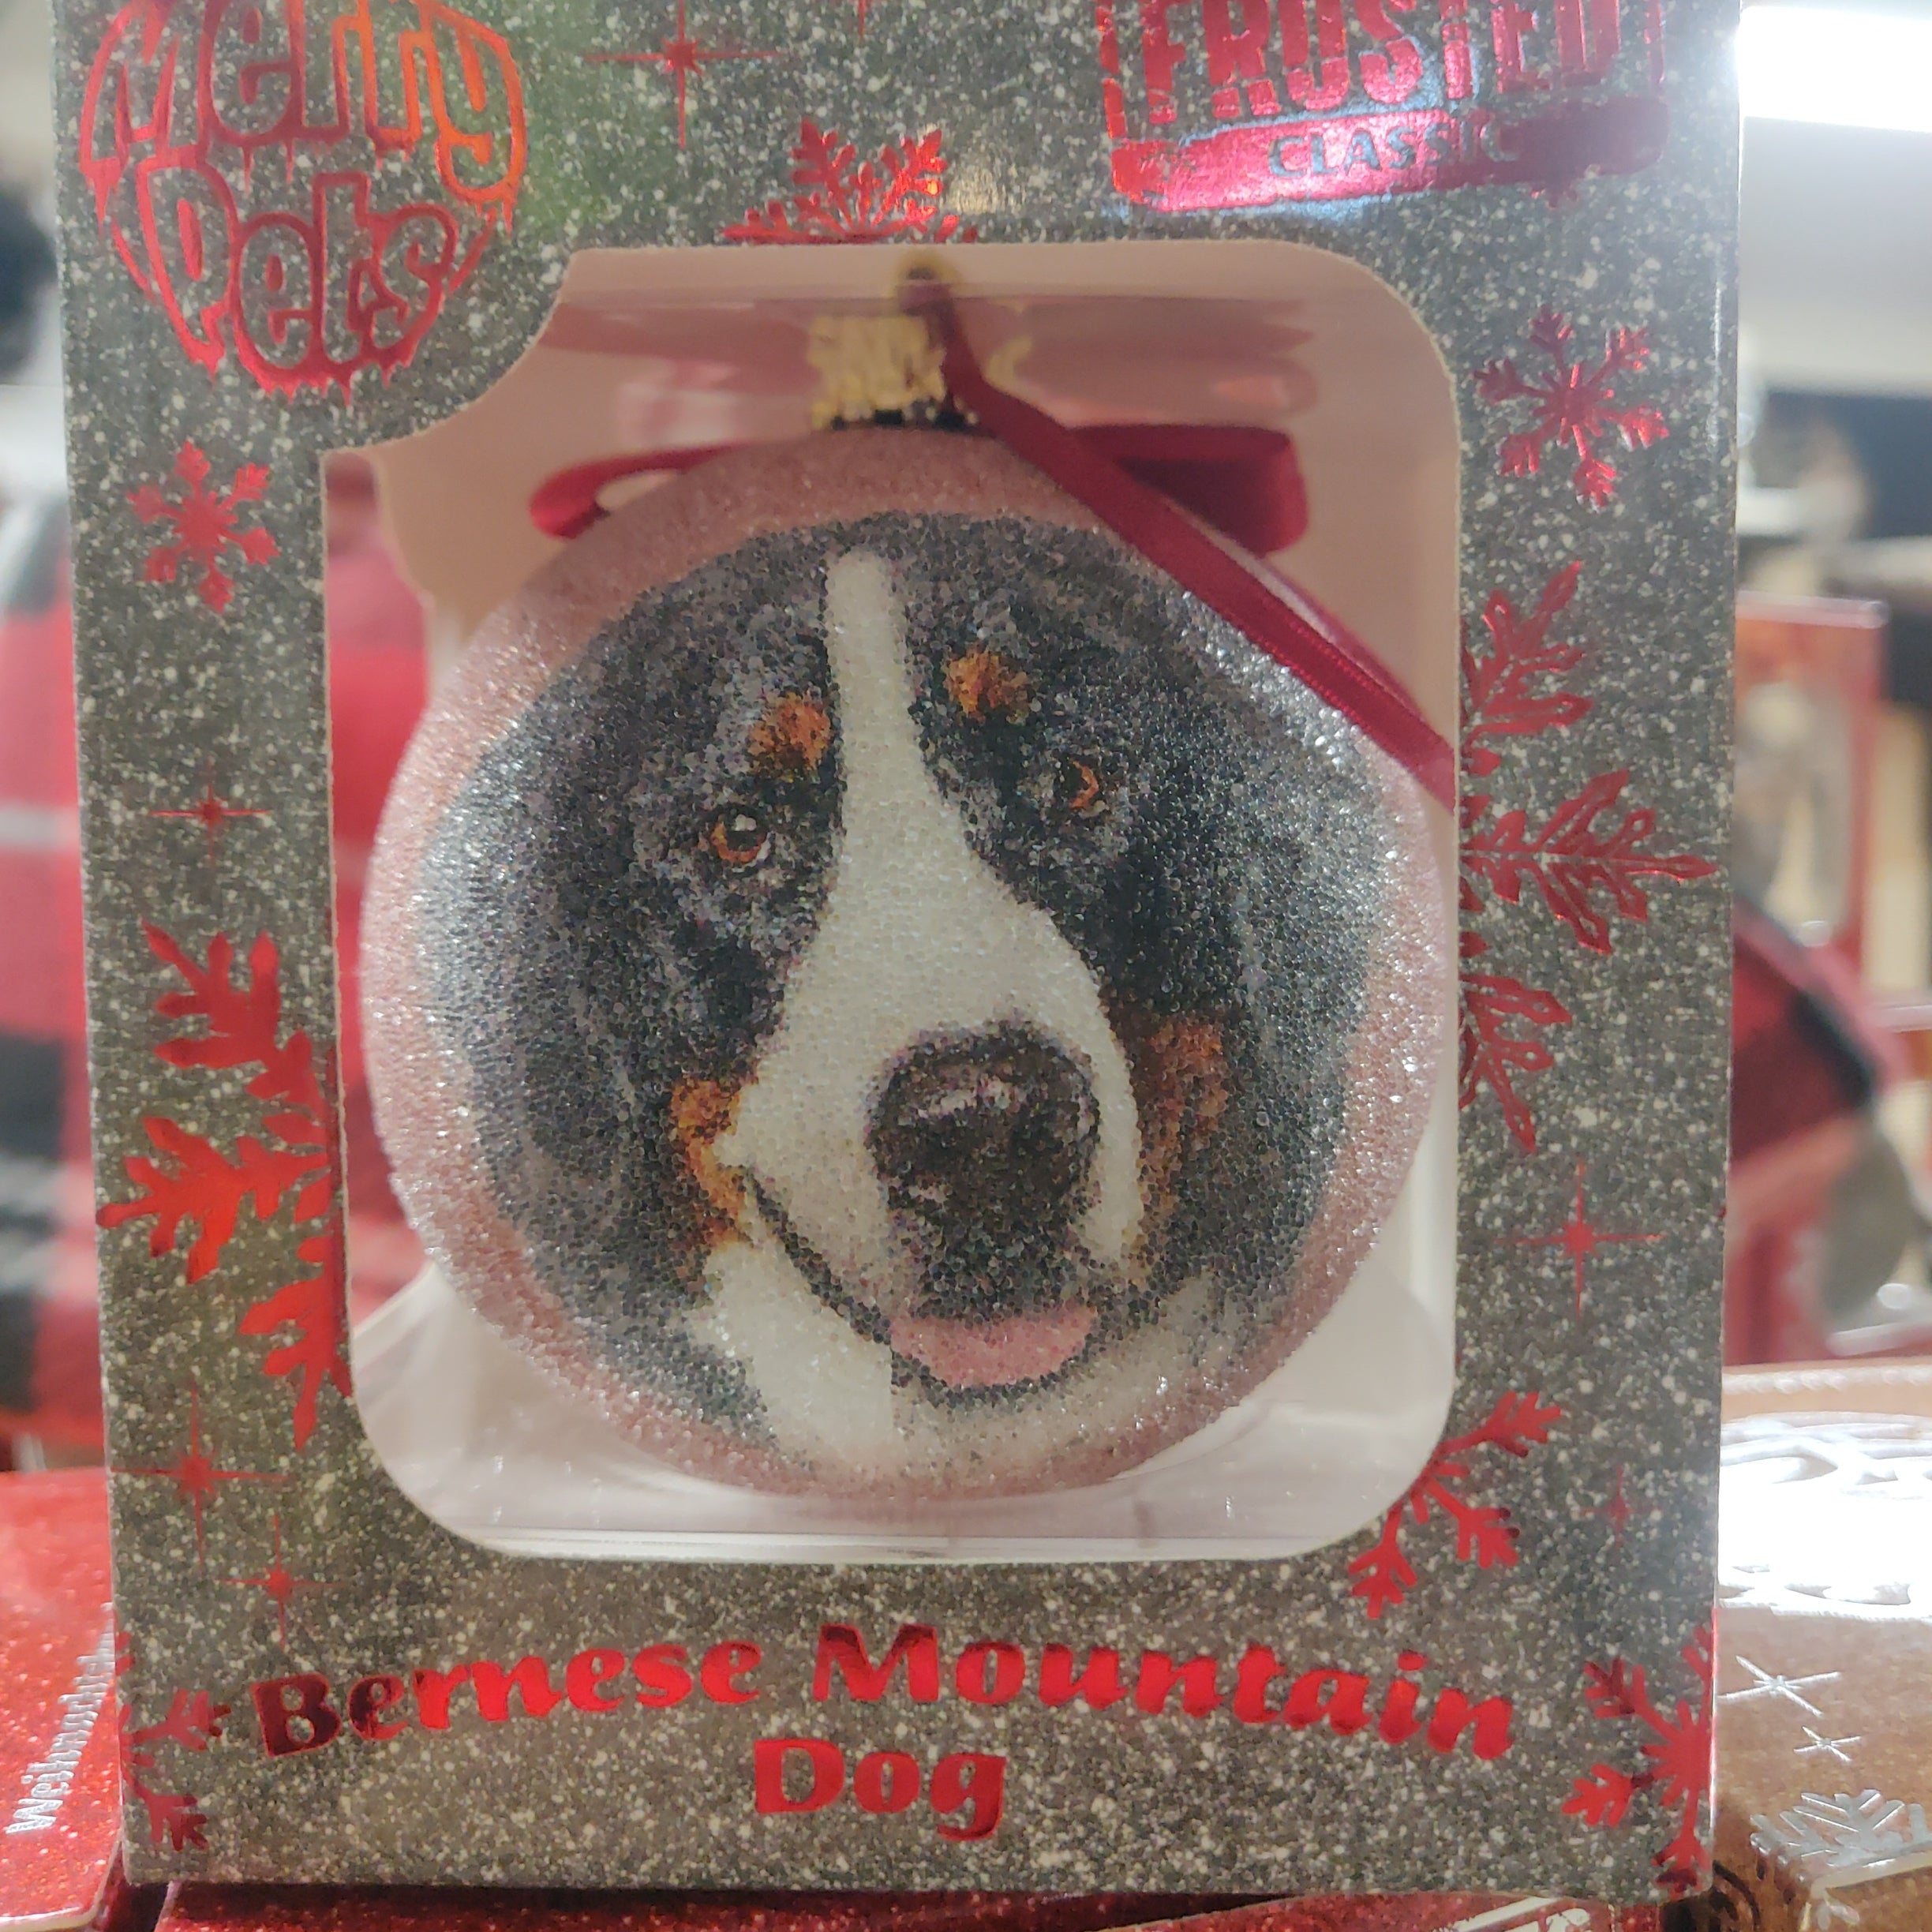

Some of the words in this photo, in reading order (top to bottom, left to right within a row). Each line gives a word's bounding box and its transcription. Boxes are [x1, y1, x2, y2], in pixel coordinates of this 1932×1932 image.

[1267, 120, 1520, 179] CLASSIC
[136, 156, 459, 388] Pets
[250, 1640, 762, 1757] Bernese
[812, 1623, 1515, 1759] Mountain
[753, 1738, 1007, 1841] Dog
